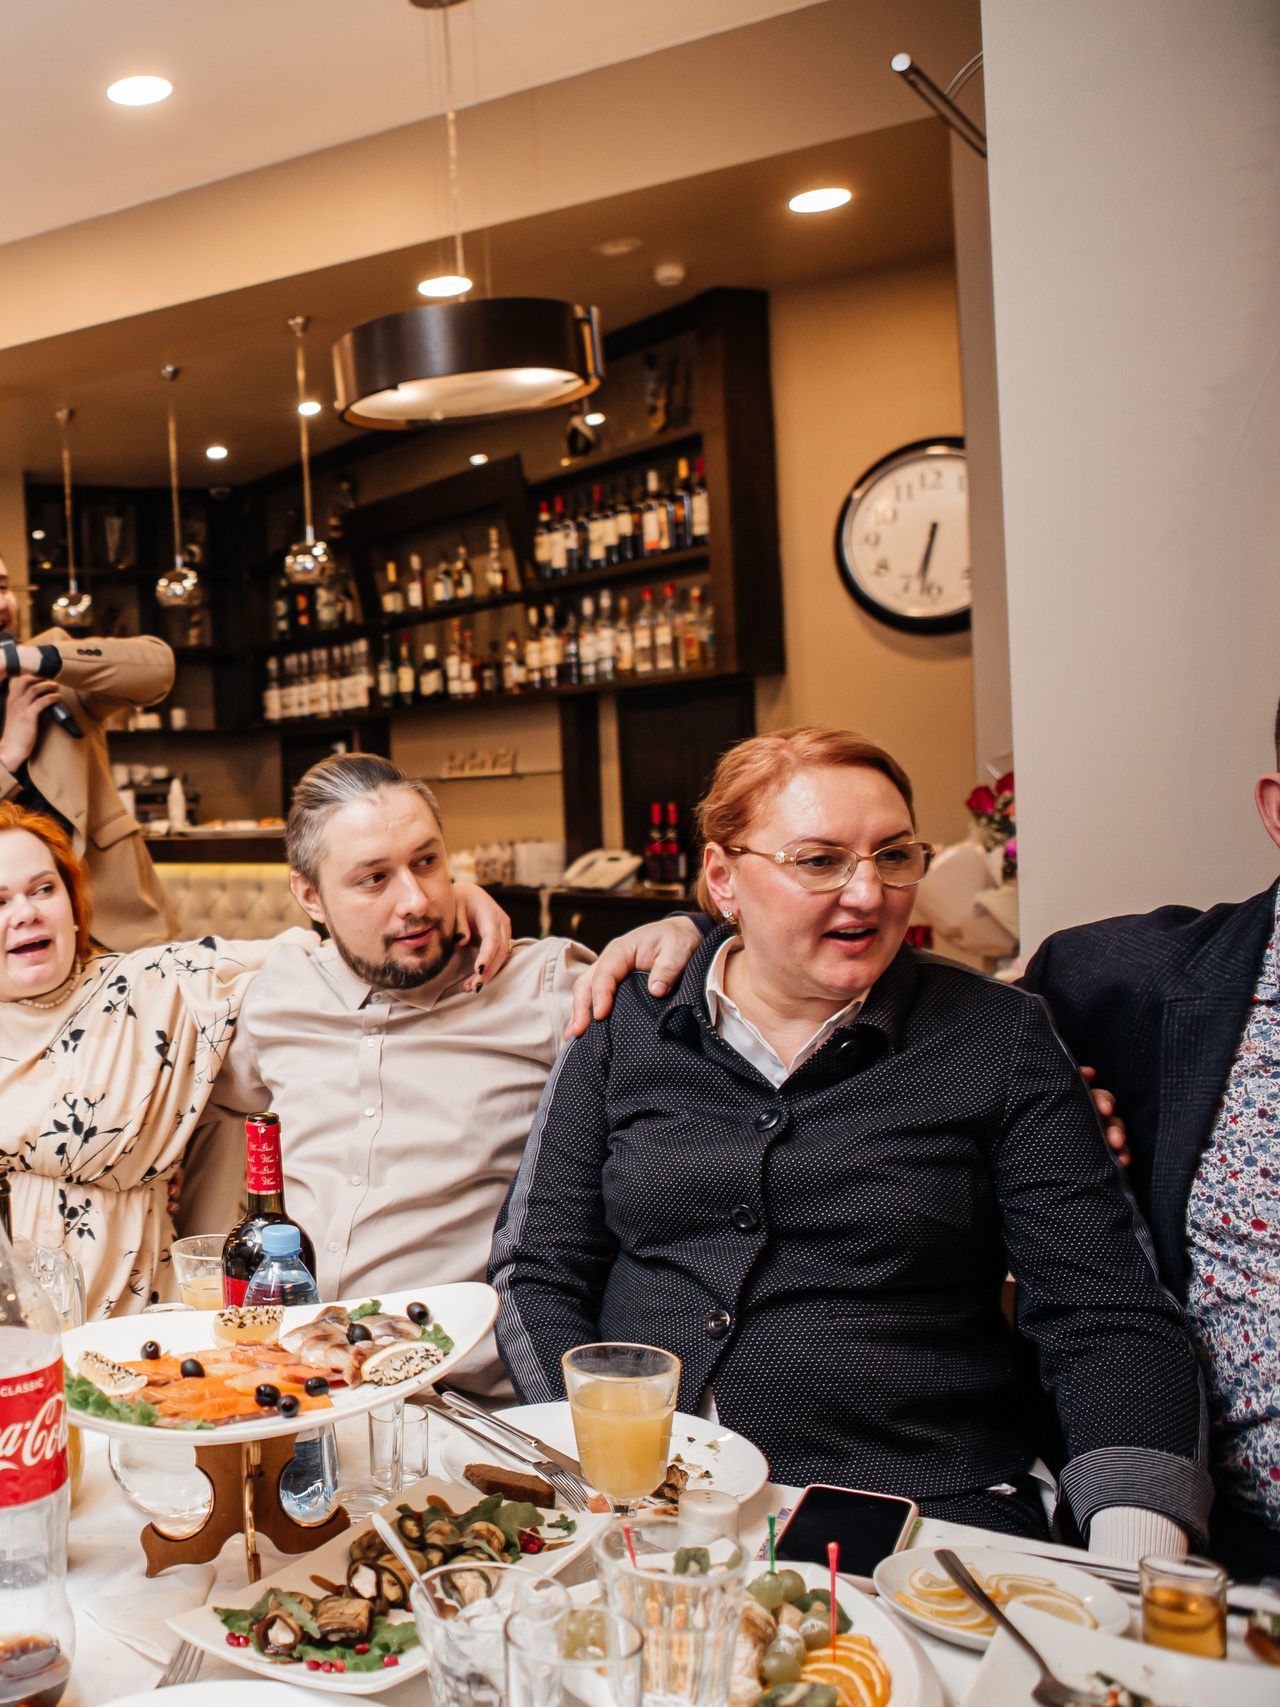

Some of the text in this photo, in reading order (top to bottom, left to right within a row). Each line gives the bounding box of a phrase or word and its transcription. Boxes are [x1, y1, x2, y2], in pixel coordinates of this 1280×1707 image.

[920, 470, 945, 490] 12
[894, 481, 915, 501] 11
[0, 1377, 44, 1397] CLASSIC
